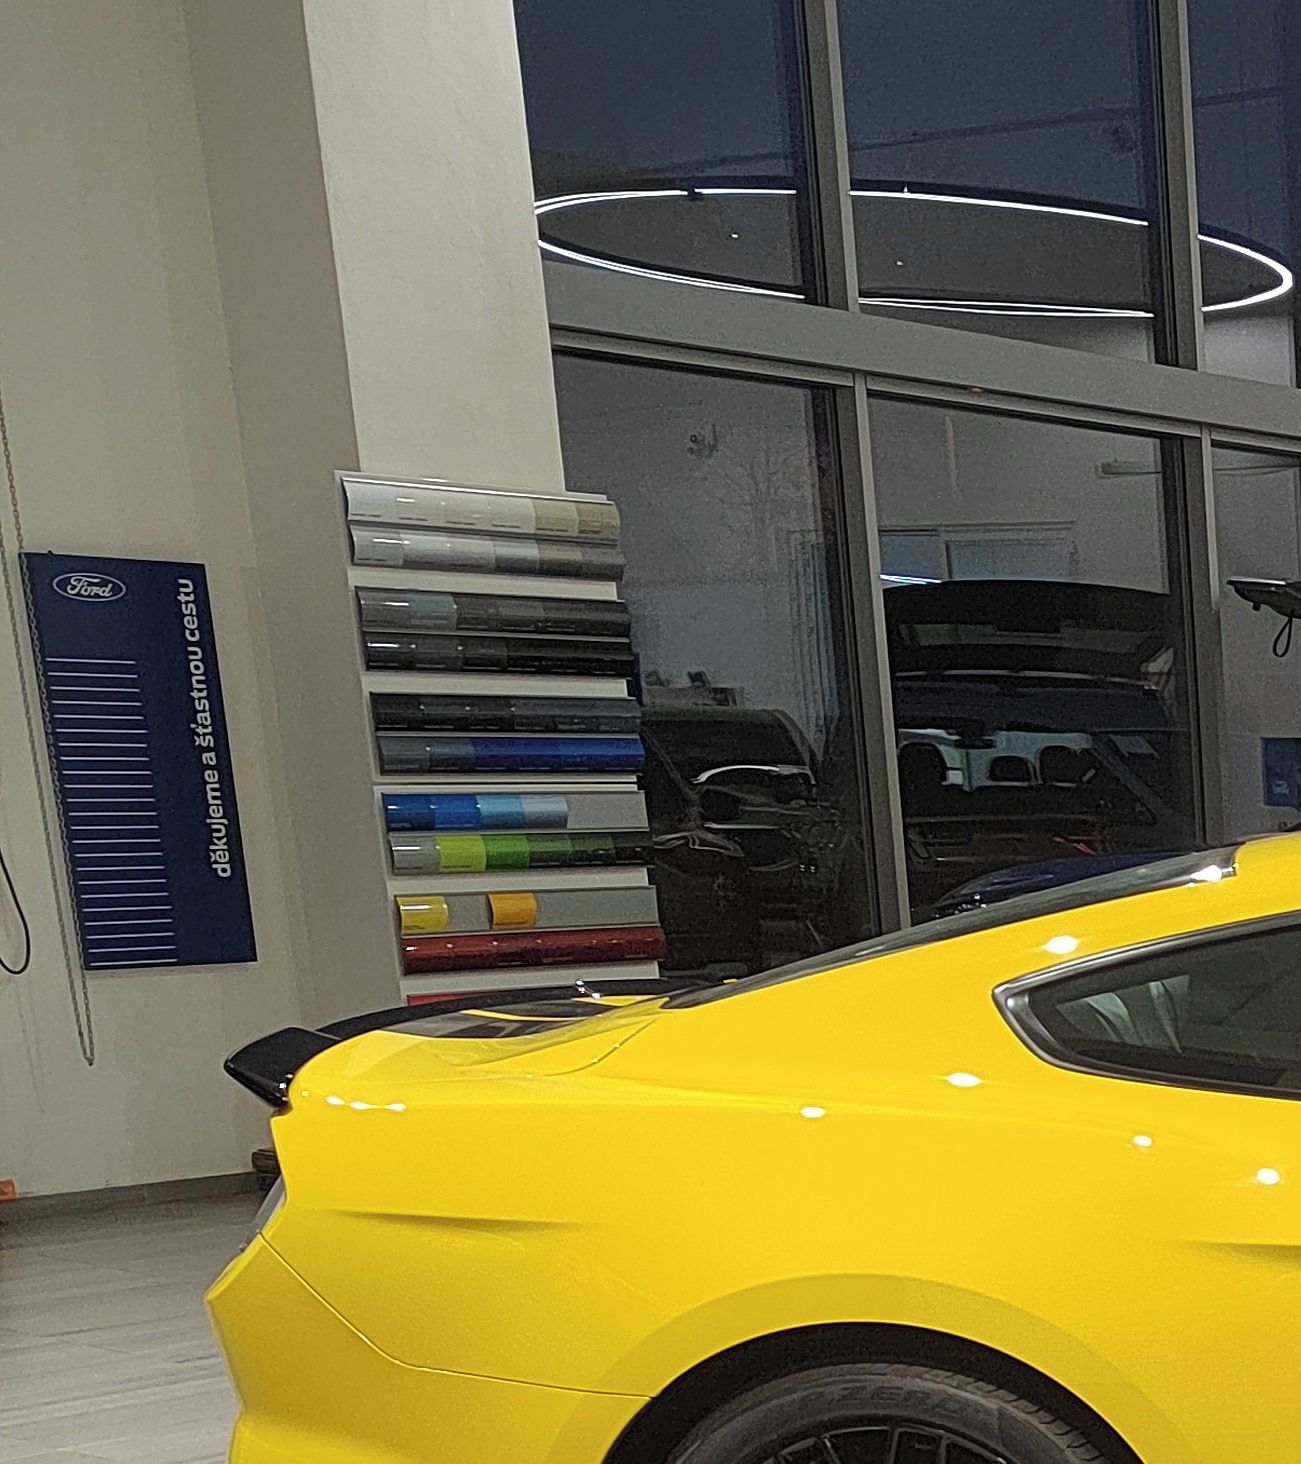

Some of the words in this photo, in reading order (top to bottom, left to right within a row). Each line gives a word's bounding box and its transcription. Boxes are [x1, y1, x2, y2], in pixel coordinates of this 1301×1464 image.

[177, 578, 200, 642] cestu
[188, 646, 214, 748] šťastnou
[202, 751, 217, 766] a
[204, 769, 232, 878] děkujeme
